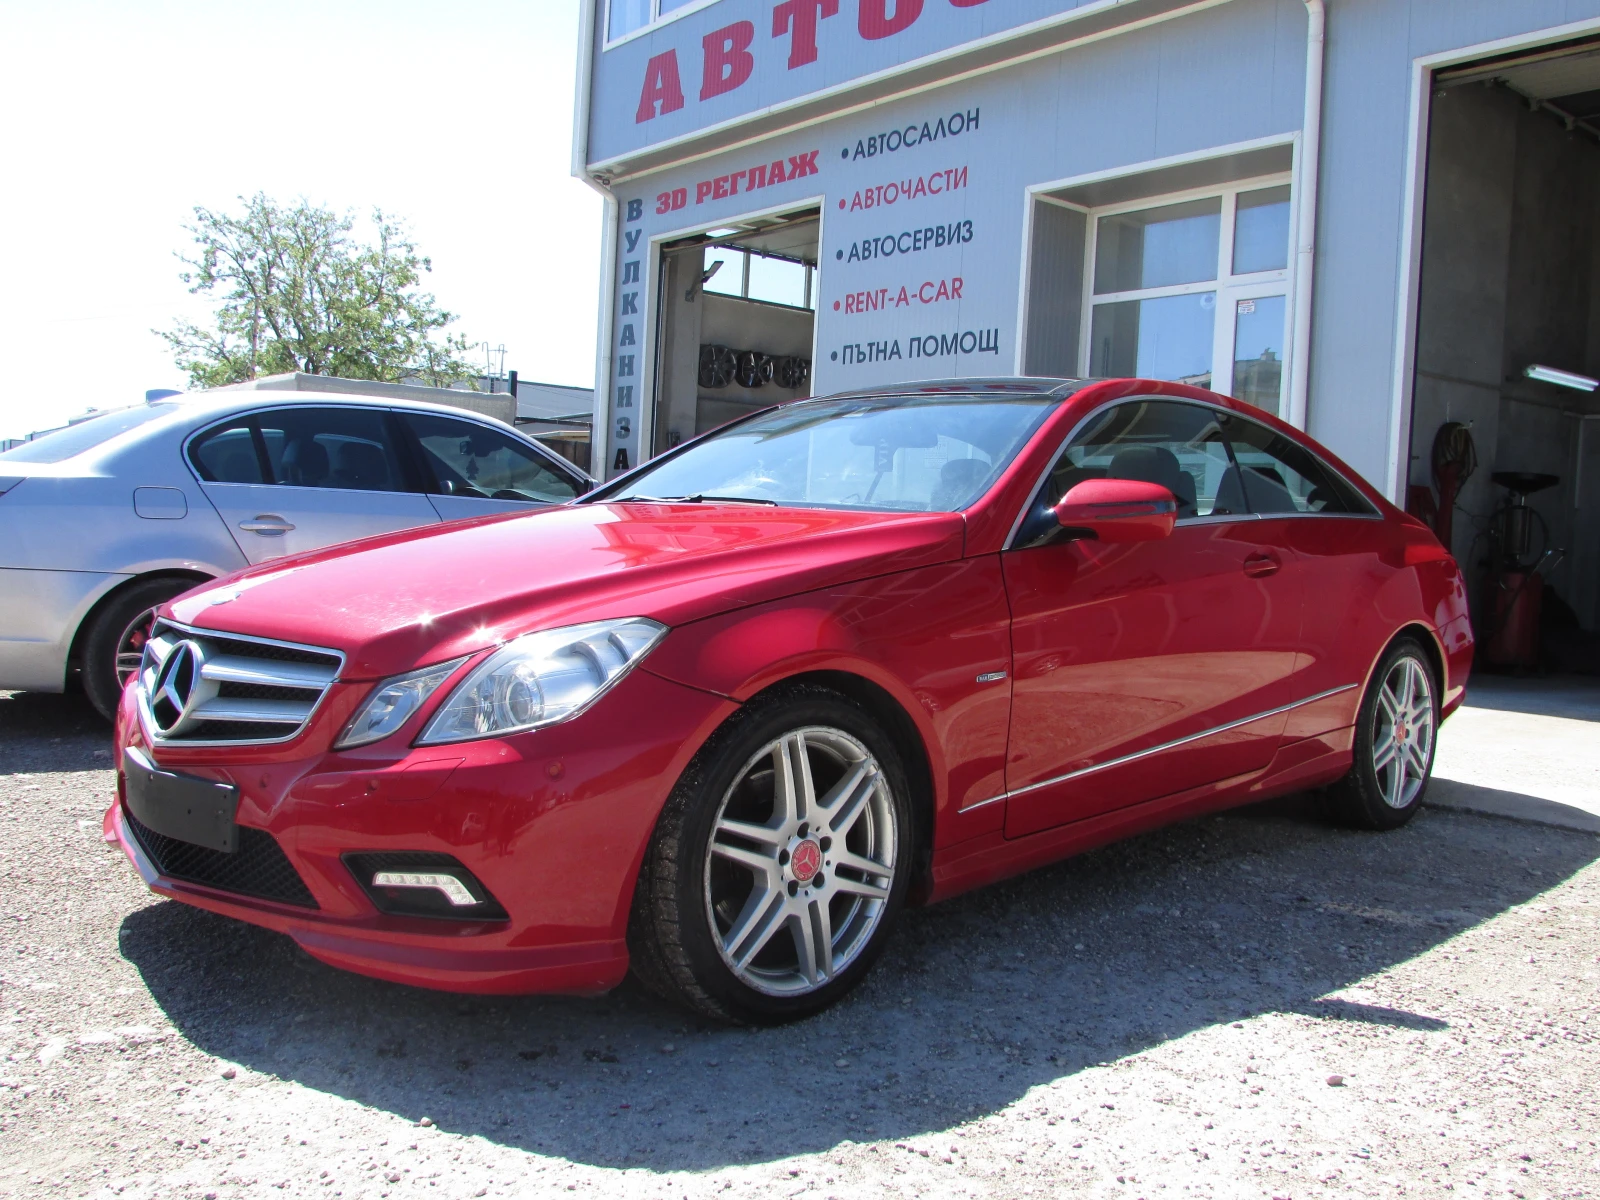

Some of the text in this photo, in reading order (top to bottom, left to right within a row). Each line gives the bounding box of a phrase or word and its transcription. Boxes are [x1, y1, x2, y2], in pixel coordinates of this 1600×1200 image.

[635, 0, 990, 124] АВТО
[852, 108, 980, 161] АВТОСАЛОН
[656, 150, 819, 215] 3D РЕГЛАЖ
[850, 166, 968, 212] АВТОЧАСТИ
[847, 220, 974, 263] АВТОСЕРВИЗ
[844, 277, 963, 314] RENT-A-CAR
[842, 328, 999, 365] ПЪТНА ПОМОЩ
